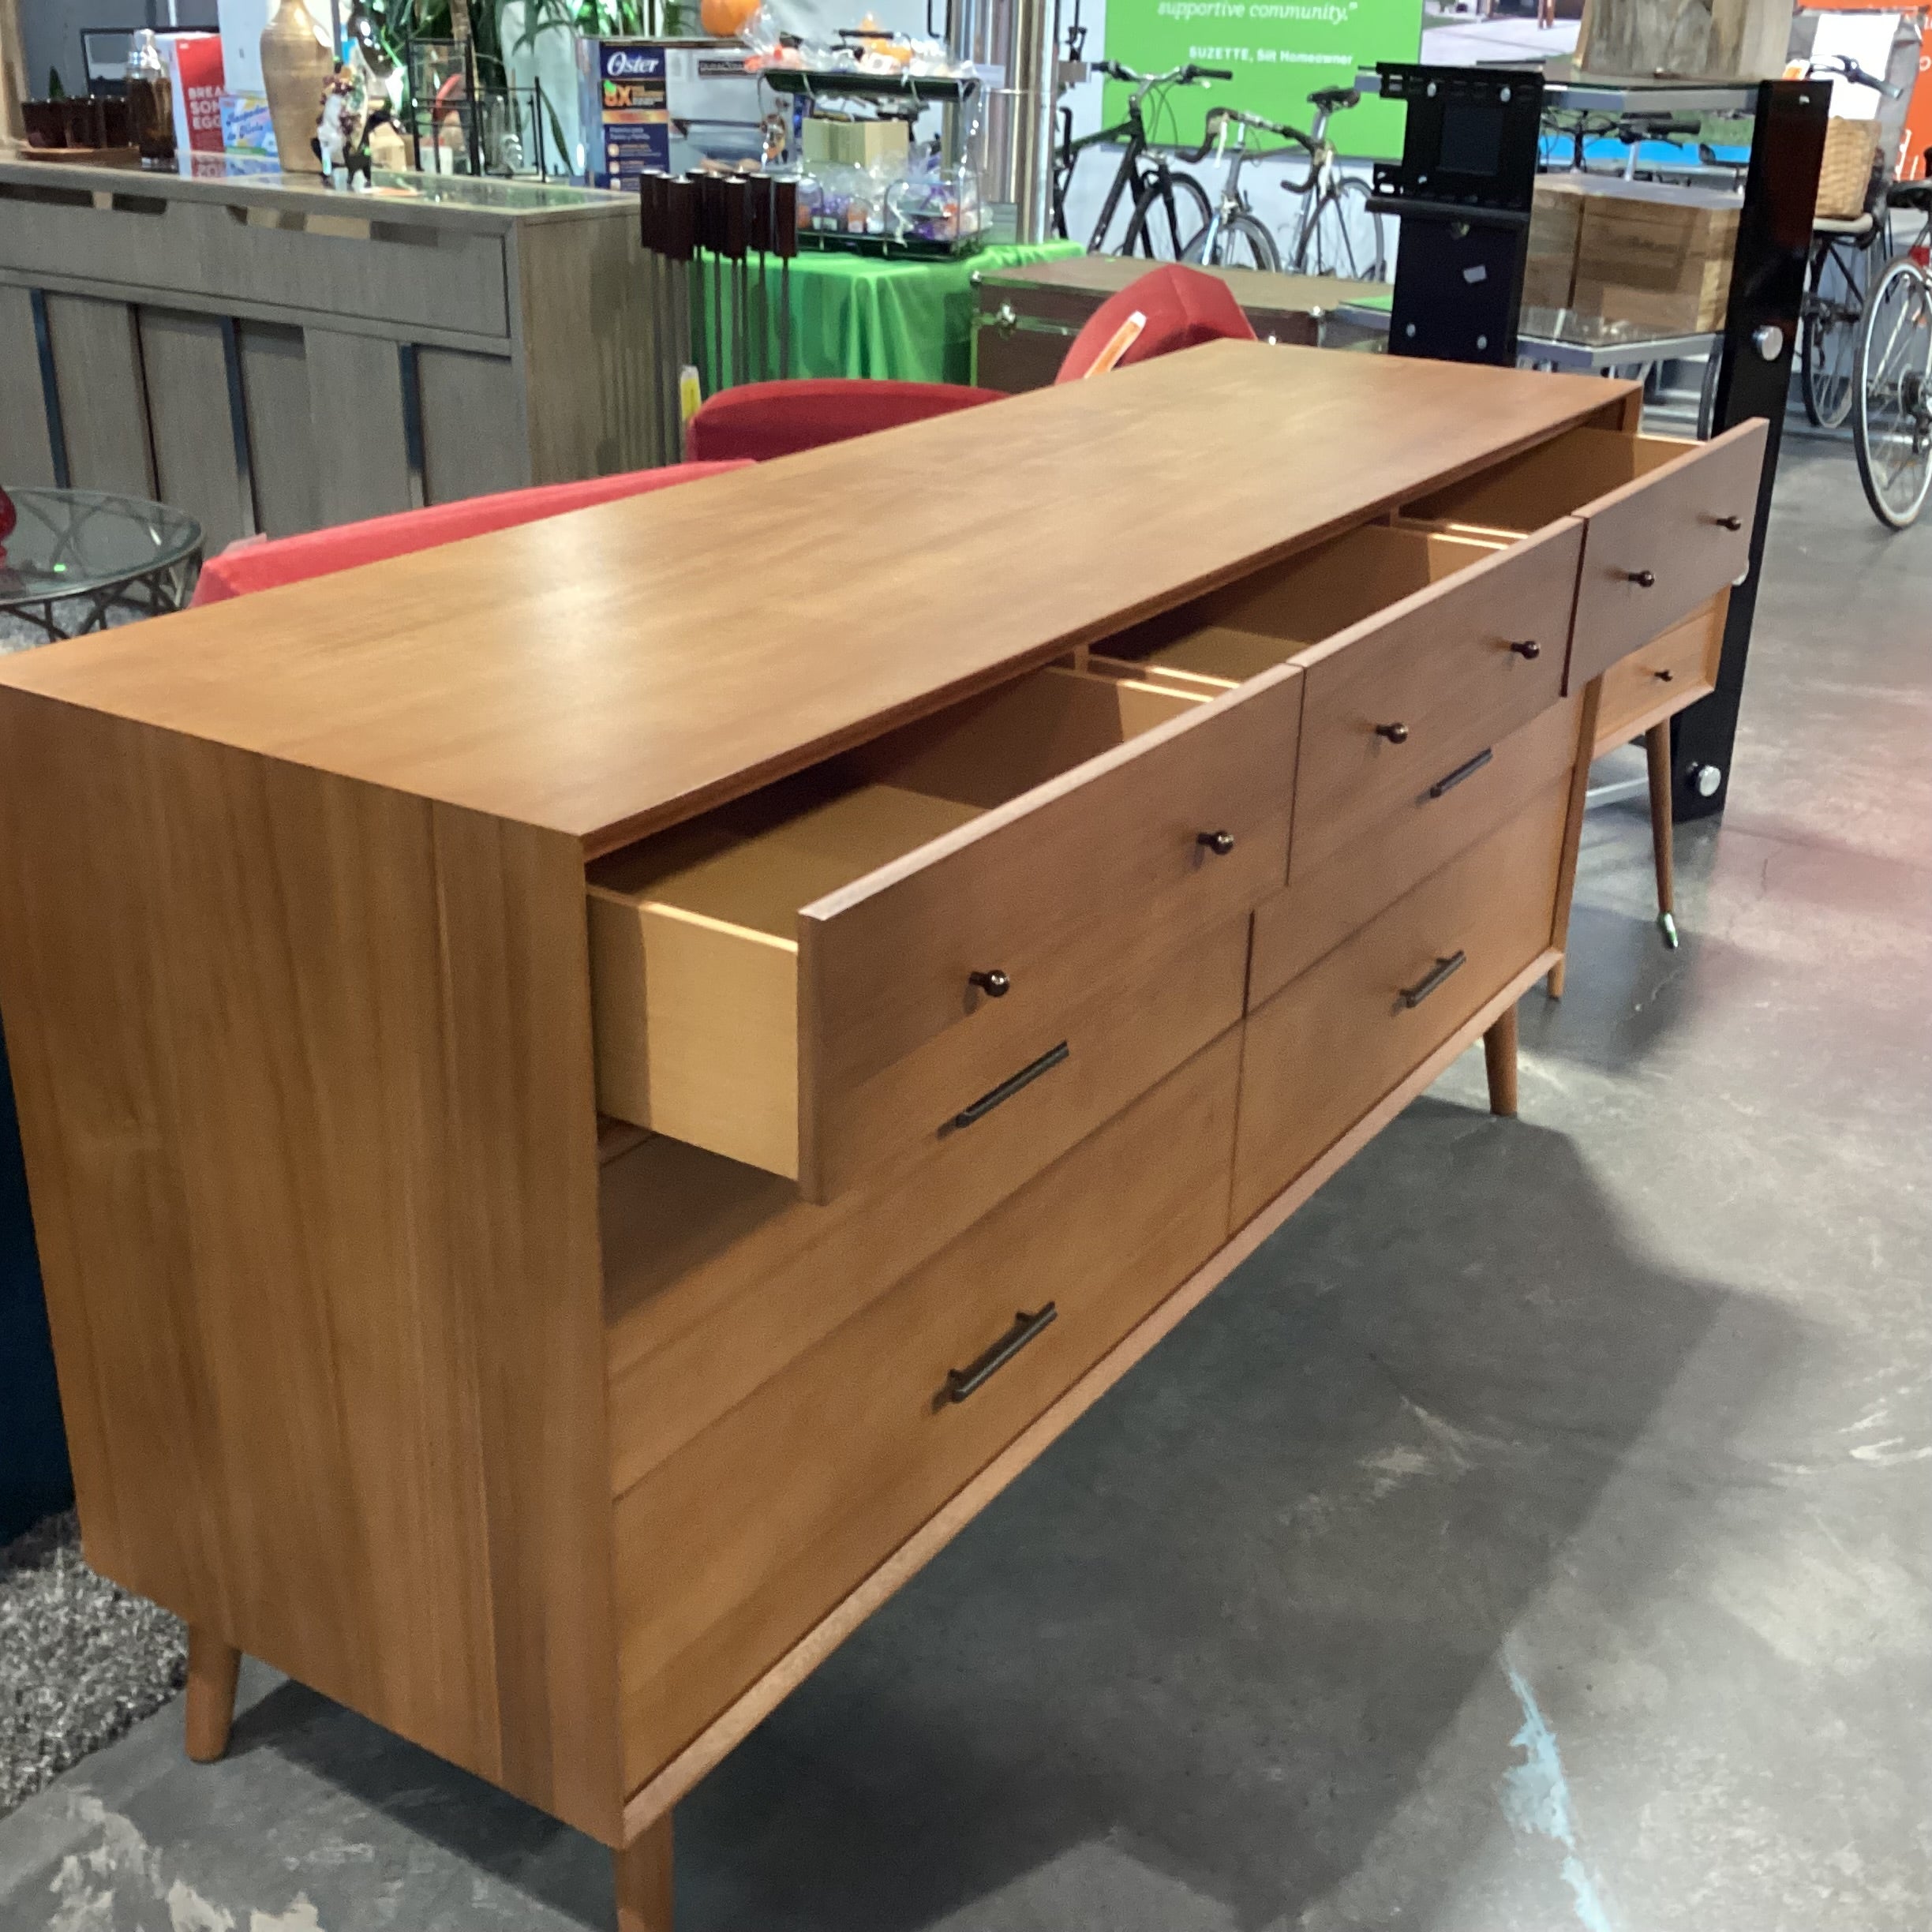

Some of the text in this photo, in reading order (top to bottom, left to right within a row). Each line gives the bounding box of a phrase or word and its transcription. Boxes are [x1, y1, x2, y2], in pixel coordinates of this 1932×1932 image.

[1157, 1, 1245, 21] supportive
[607, 51, 660, 77] Oster
[1189, 46, 1253, 62] SUZETTE,
[1280, 51, 1353, 66] Homeowner
